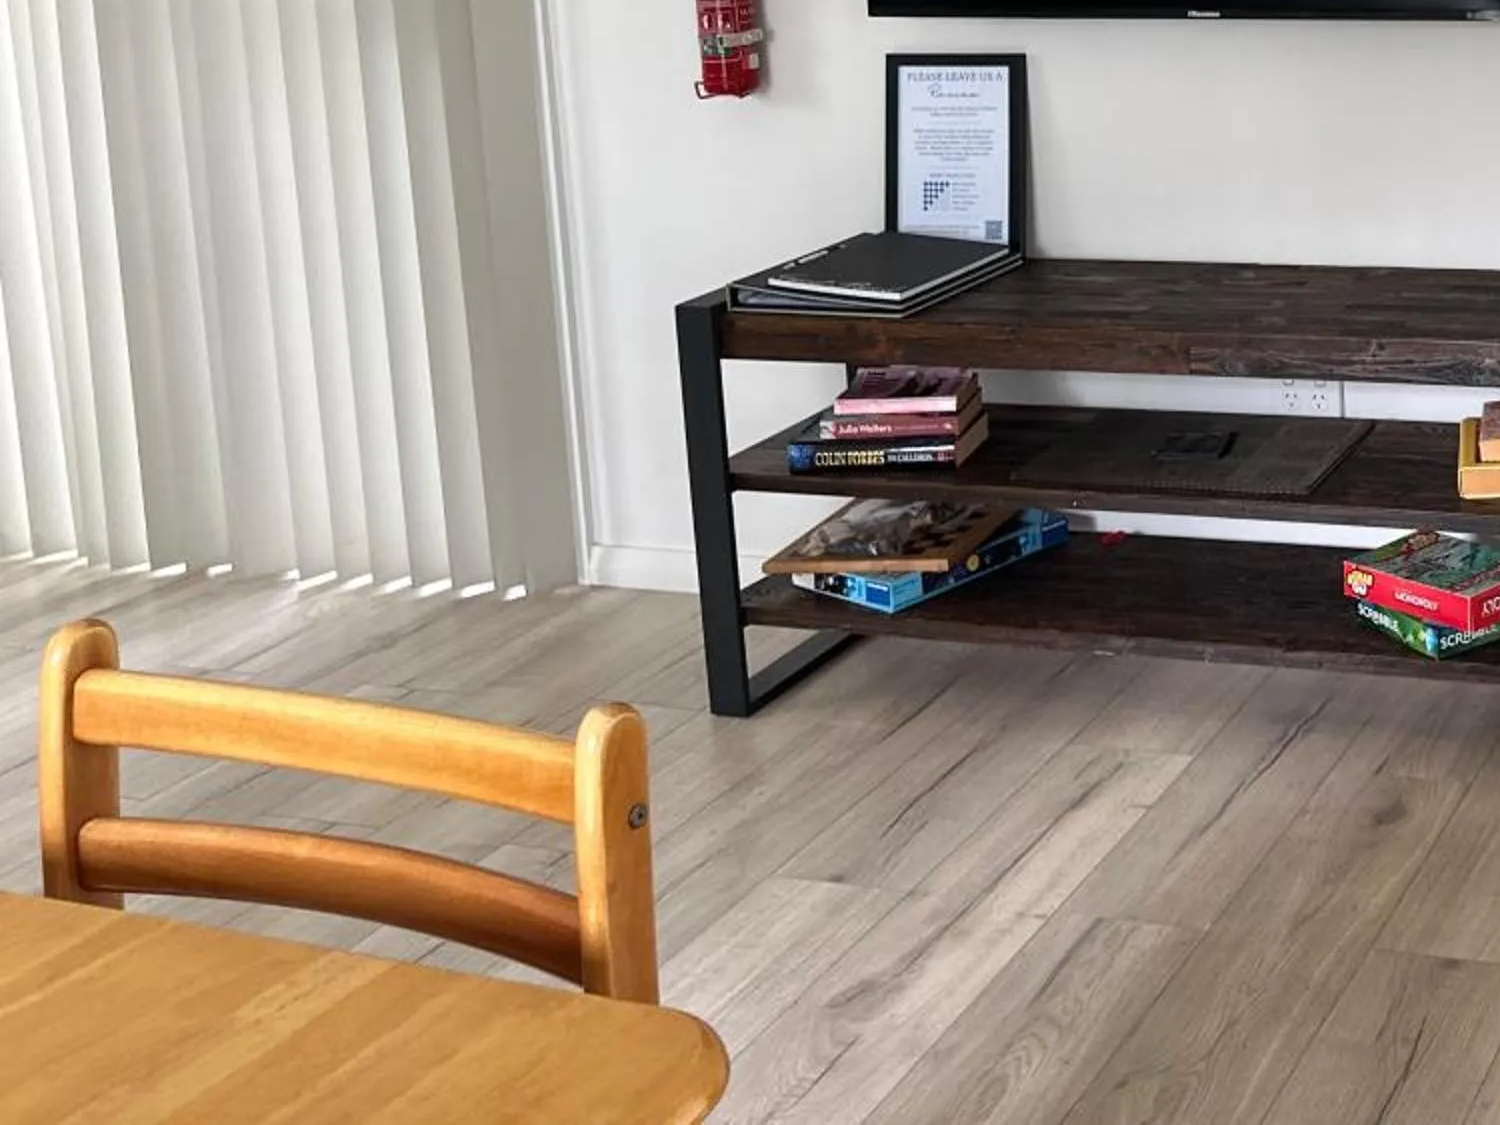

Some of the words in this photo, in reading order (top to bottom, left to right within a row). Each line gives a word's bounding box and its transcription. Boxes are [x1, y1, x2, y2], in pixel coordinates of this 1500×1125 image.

[907, 72, 944, 83] PLEASE
[946, 72, 976, 83] LEAVE
[815, 452, 847, 467] COLIN
[848, 450, 885, 465] FORBES
[1358, 601, 1400, 632] SCRABBLE
